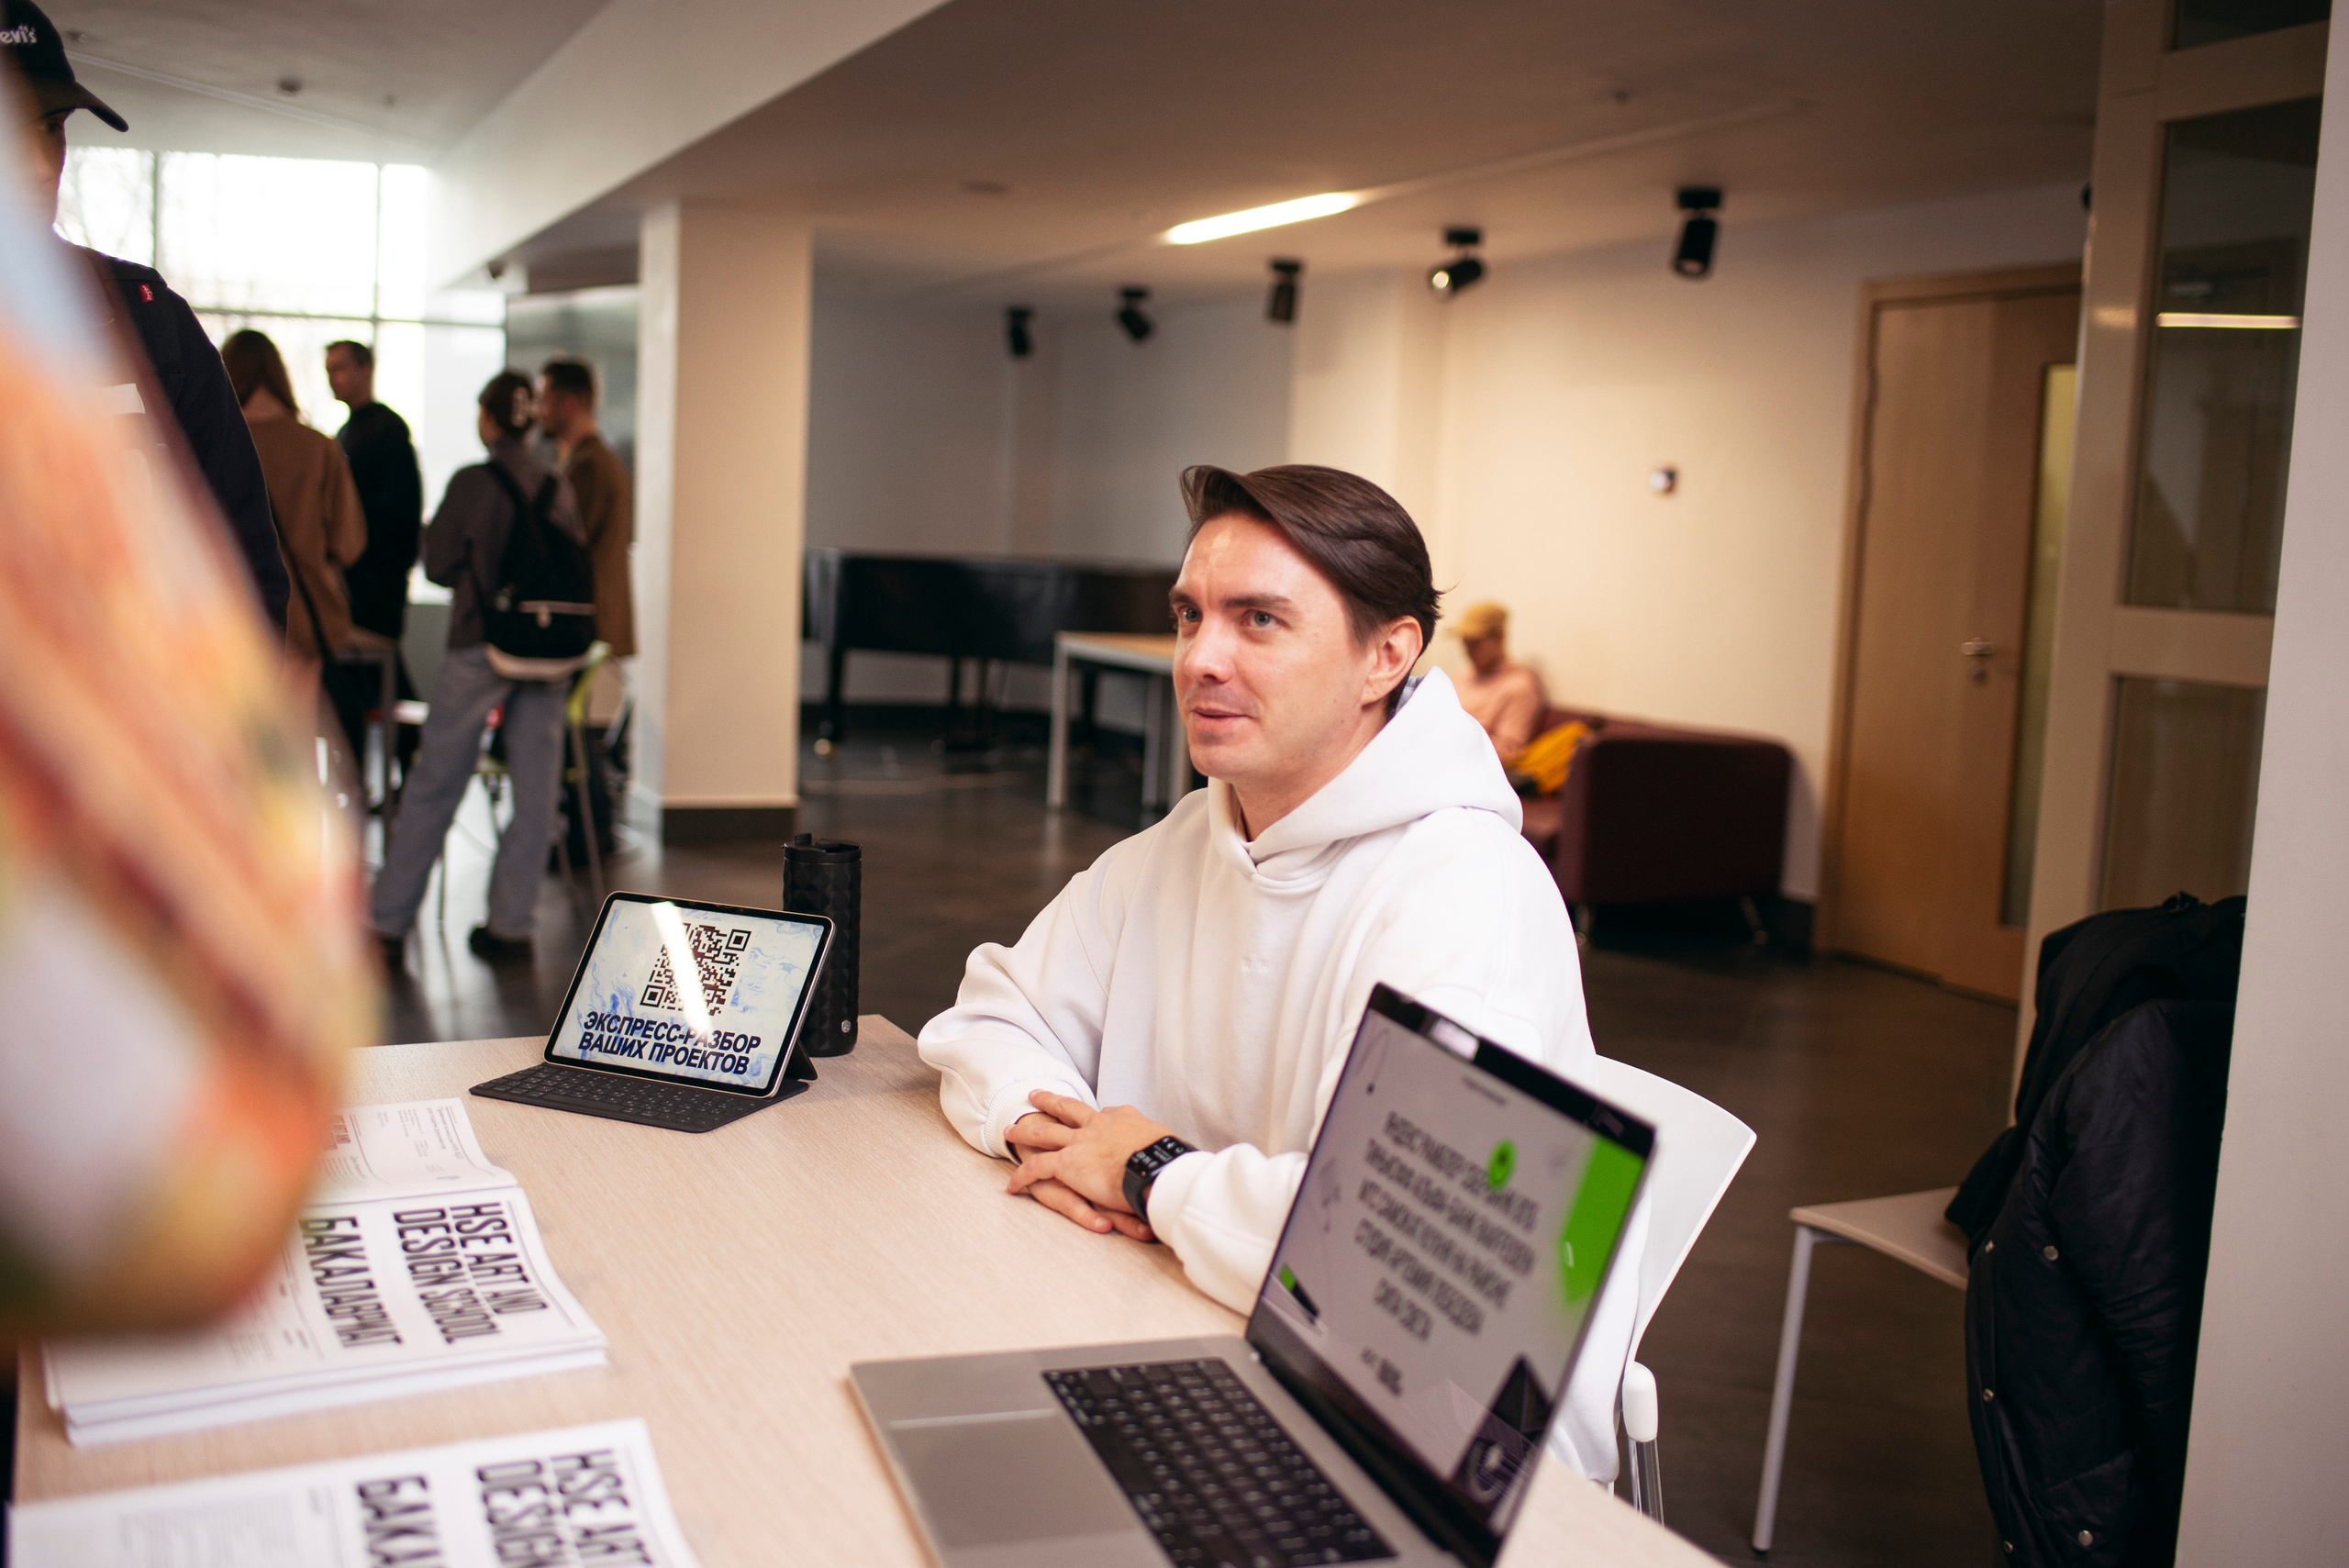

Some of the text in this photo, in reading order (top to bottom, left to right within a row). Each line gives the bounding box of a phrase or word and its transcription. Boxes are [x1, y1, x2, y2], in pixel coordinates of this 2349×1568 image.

[0, 25, 37, 43] evi's
[577, 1031, 750, 1075] ВАШИХ ПРОЕКТОВ
[583, 1011, 762, 1054] ЭКСПРЕСС-РАЗБОР
[298, 1216, 405, 1348] БАКАЛАВРИАТ
[393, 1207, 504, 1345] DESIGN SCHOOL
[450, 1202, 549, 1315] HSE ART AND
[356, 1474, 443, 1568] БАКА
[550, 1448, 630, 1518] HSE
